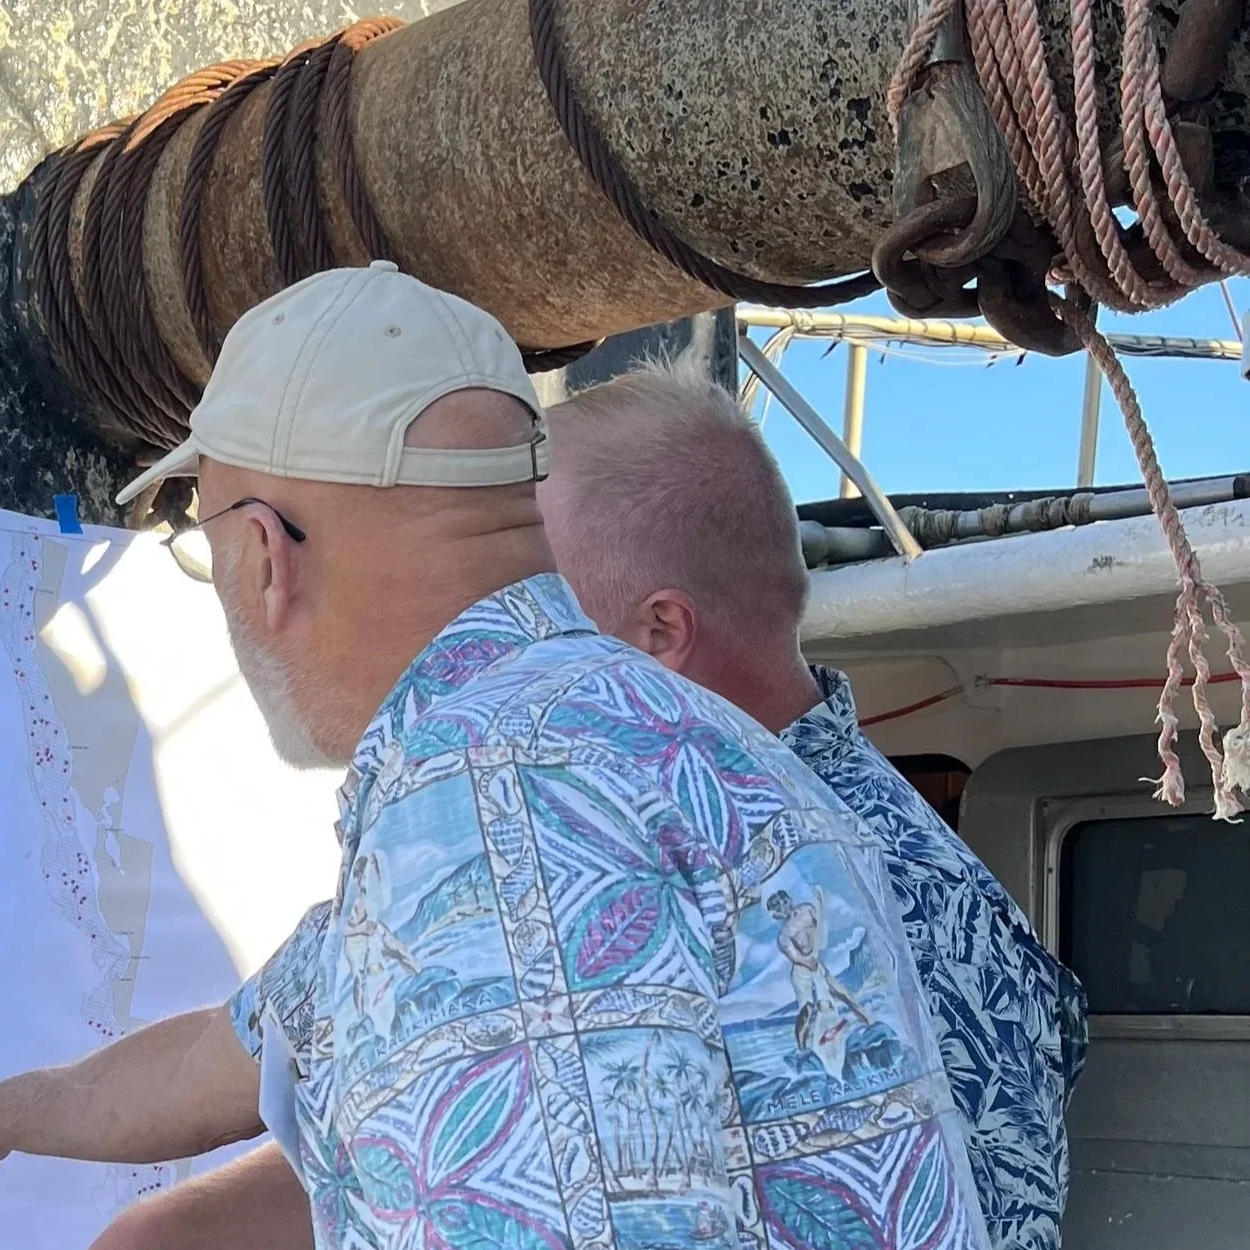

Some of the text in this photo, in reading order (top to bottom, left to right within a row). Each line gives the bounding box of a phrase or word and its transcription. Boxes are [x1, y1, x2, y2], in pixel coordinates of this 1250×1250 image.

[376, 993, 493, 1058] KALIKIMAKA
[767, 1066, 902, 1115] MELE KALIKIM
